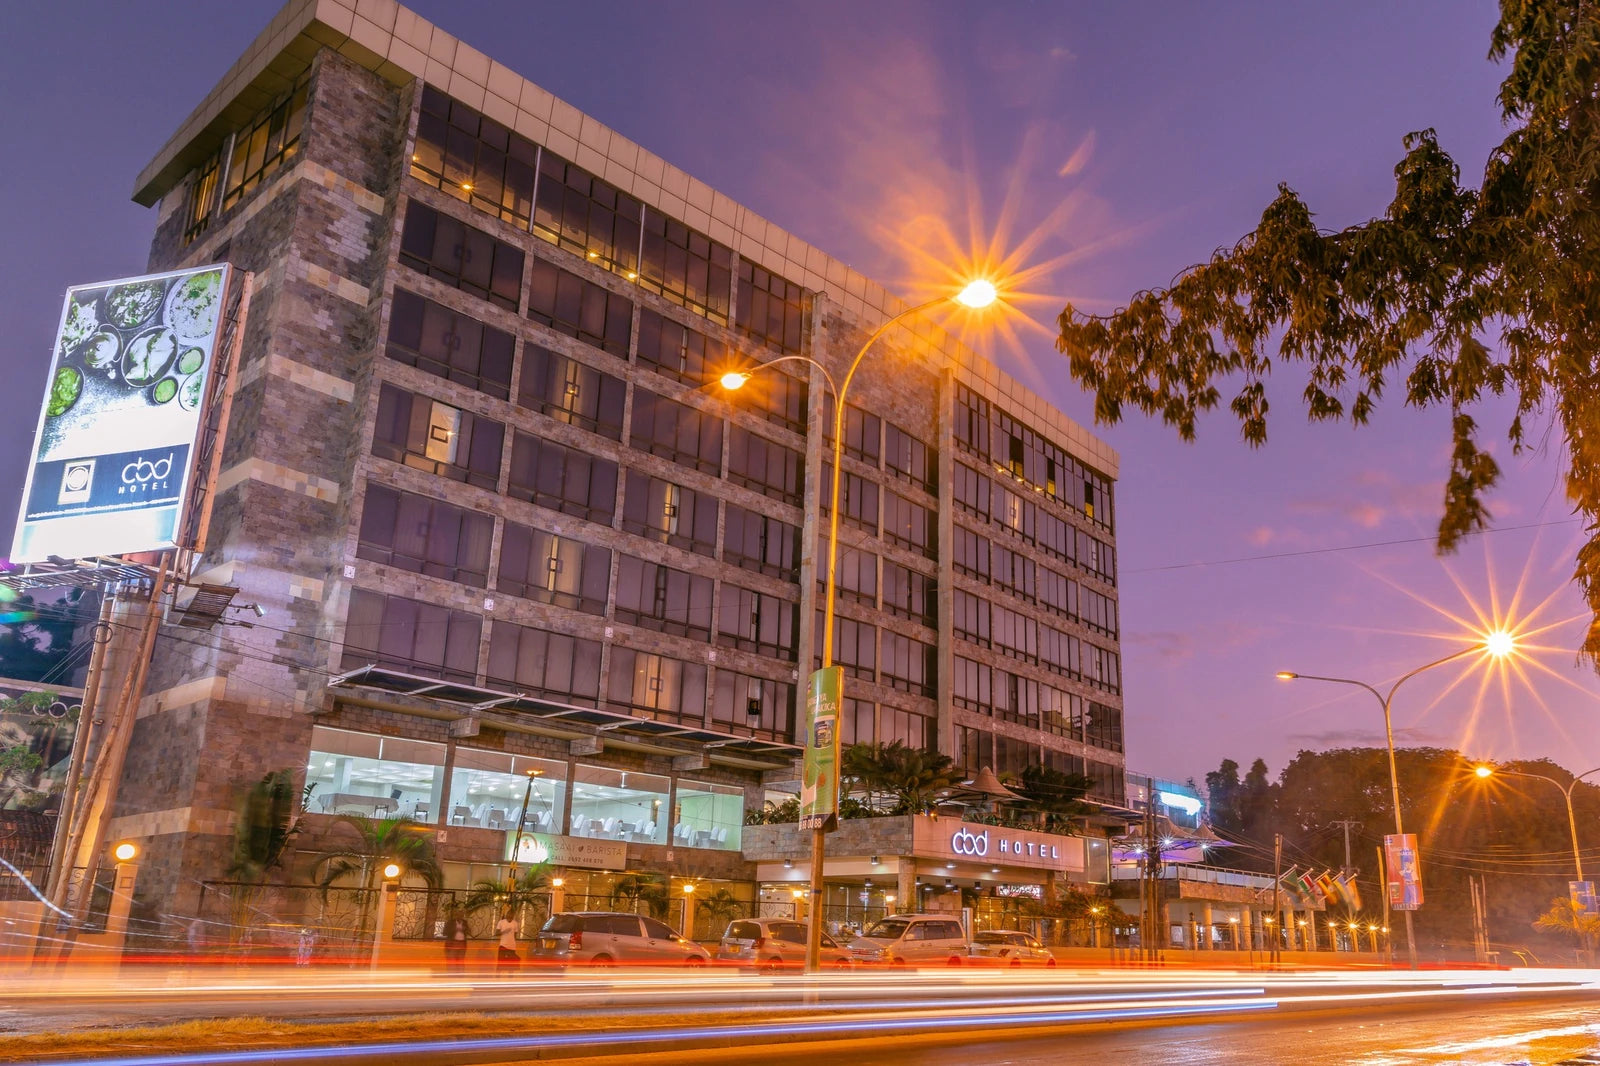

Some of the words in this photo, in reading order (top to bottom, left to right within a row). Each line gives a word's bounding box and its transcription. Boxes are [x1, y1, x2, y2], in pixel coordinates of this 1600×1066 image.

[121, 452, 174, 484] cbd
[118, 481, 168, 494] HOTEL
[586, 845, 623, 856] BARISTA
[952, 827, 988, 856] cbd
[1000, 839, 1058, 858] HOTEL
